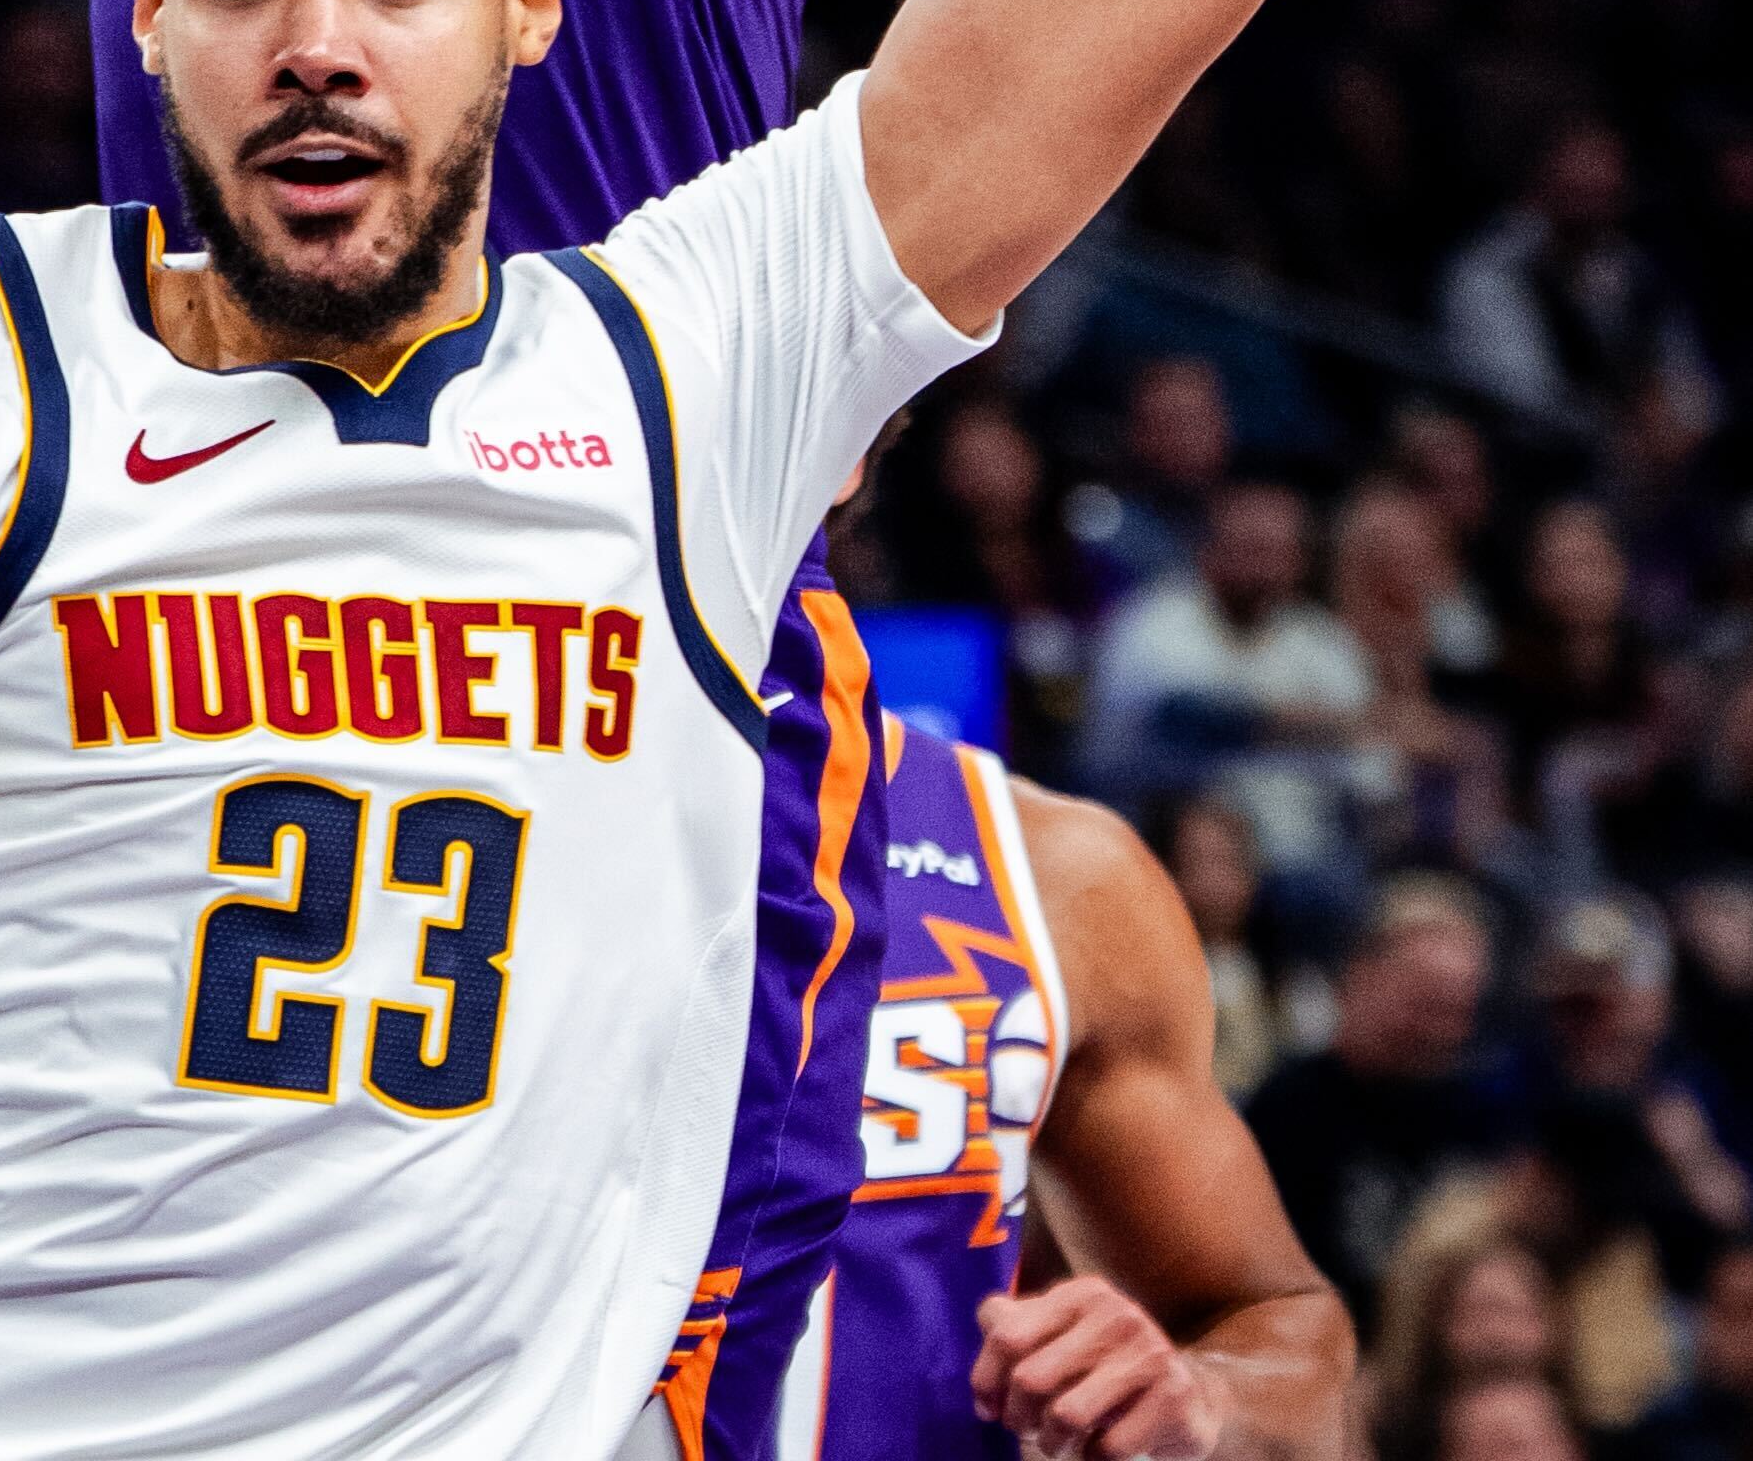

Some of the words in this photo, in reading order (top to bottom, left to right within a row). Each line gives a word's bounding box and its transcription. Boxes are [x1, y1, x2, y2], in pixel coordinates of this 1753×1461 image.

[463, 430, 613, 472] ibotta
[52, 591, 643, 763] NUGGETS
[175, 773, 532, 1120] 23
